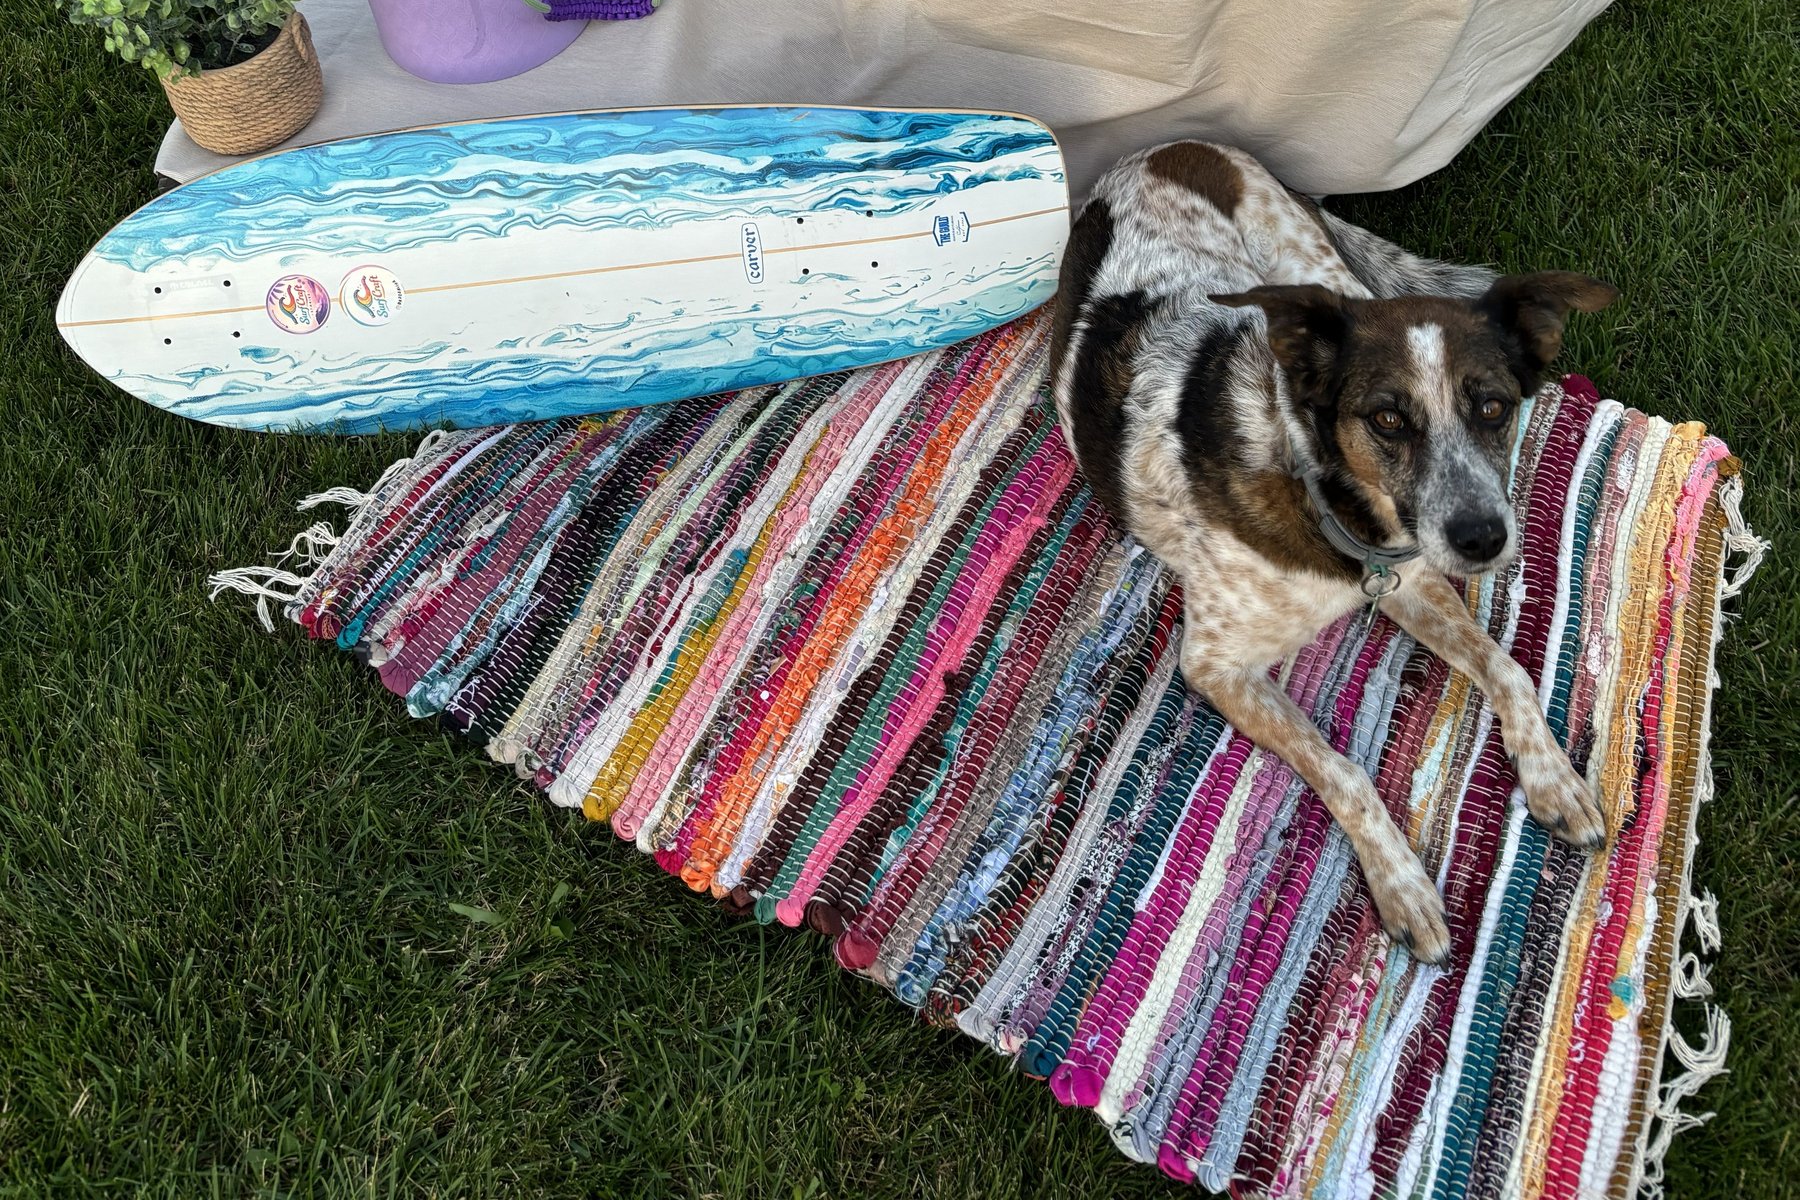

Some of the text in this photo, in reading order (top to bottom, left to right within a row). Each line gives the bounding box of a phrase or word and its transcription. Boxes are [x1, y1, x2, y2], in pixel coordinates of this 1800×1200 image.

[745, 228, 760, 278] carver
[940, 233, 951, 245] THE
[294, 285, 310, 324] SurfCraft
[369, 275, 388, 318] SurfCraft
